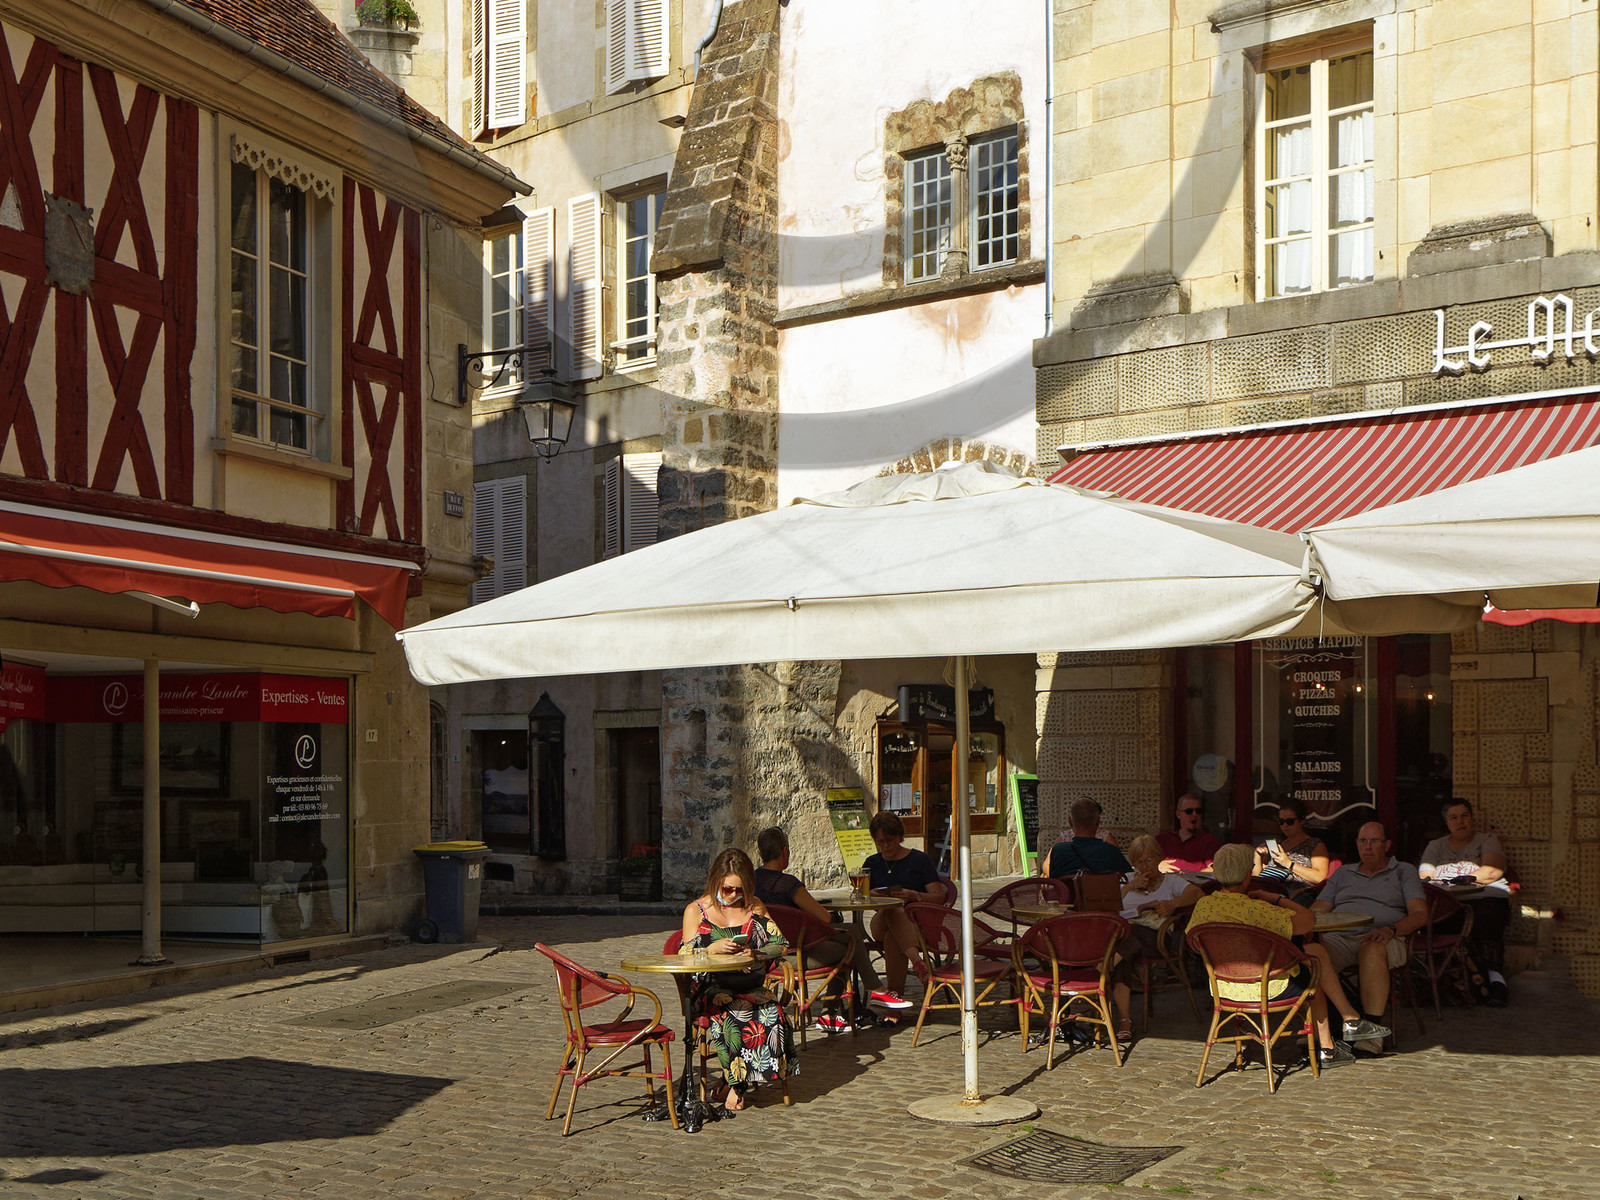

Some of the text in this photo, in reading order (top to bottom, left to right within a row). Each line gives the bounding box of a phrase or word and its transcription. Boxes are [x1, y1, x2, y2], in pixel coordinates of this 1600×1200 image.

[1431, 309, 1493, 373] Le
[1266, 635, 1363, 650] SERVICE RAPIDE
[1293, 671, 1341, 682] CROQUES
[202, 679, 249, 700] Landre
[1299, 688, 1336, 699] PIZZAS
[262, 689, 309, 706] Expertises
[317, 691, 345, 706] Ventes
[159, 706, 224, 717] ommissaire-priseur
[1294, 705, 1340, 717] QUICHES
[1294, 761, 1341, 772] SALADES
[266, 775, 288, 785] Expertises
[288, 776, 310, 784] gracieuses
[275, 785, 291, 794] chaque
[291, 784, 309, 792] vendredi
[1294, 789, 1342, 801] GAUFRES
